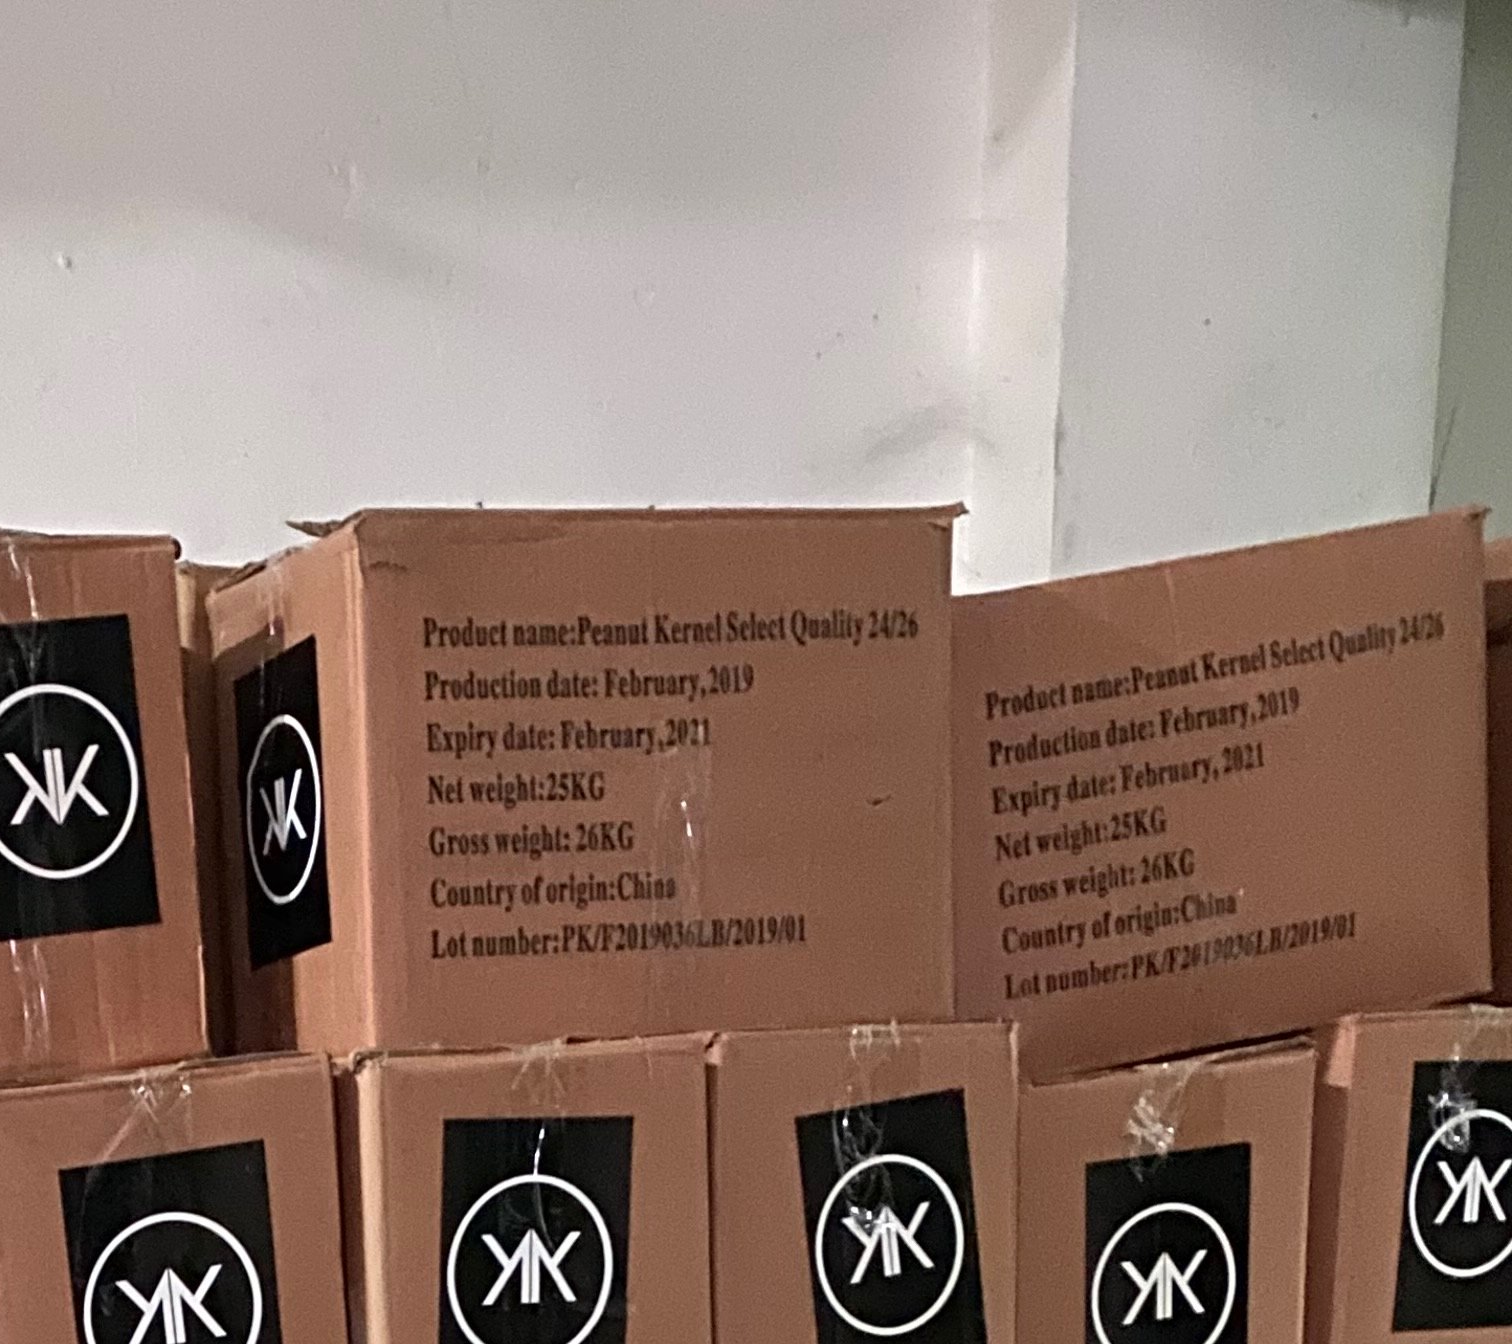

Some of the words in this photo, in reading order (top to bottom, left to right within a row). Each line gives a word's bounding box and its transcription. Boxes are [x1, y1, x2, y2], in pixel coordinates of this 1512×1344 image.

[423, 616, 507, 648] Product
[654, 611, 721, 644] Kernel
[727, 610, 786, 642] Select
[791, 609, 864, 646] Quality
[868, 609, 919, 639] 24/26
[425, 669, 541, 700] Production
[547, 669, 598, 698] date:
[985, 683, 1066, 721] Product
[1201, 644, 1266, 681] Kernel
[1270, 636, 1325, 669] Select
[1329, 623, 1396, 663] Quality
[1399, 611, 1445, 645] 24/26
[427, 722, 497, 759] Expiry
[503, 721, 555, 750] date:
[989, 726, 1101, 768] Production
[1105, 719, 1155, 747] date:
[428, 774, 463, 804] Net
[992, 781, 1061, 817] Expiry
[1067, 774, 1116, 803] date:
[429, 826, 489, 857] Gross
[495, 824, 570, 861] weight:
[576, 821, 634, 851] 26KG
[995, 832, 1030, 861] Net
[431, 877, 518, 912] Country
[521, 875, 544, 905] of
[998, 879, 1058, 909] Gross
[1062, 862, 1136, 898] weight:
[1140, 848, 1196, 885] 26KG
[431, 929, 466, 959] Lot
[1002, 921, 1086, 955] Country
[1091, 910, 1112, 940] of
[1004, 972, 1041, 1000] Lot
